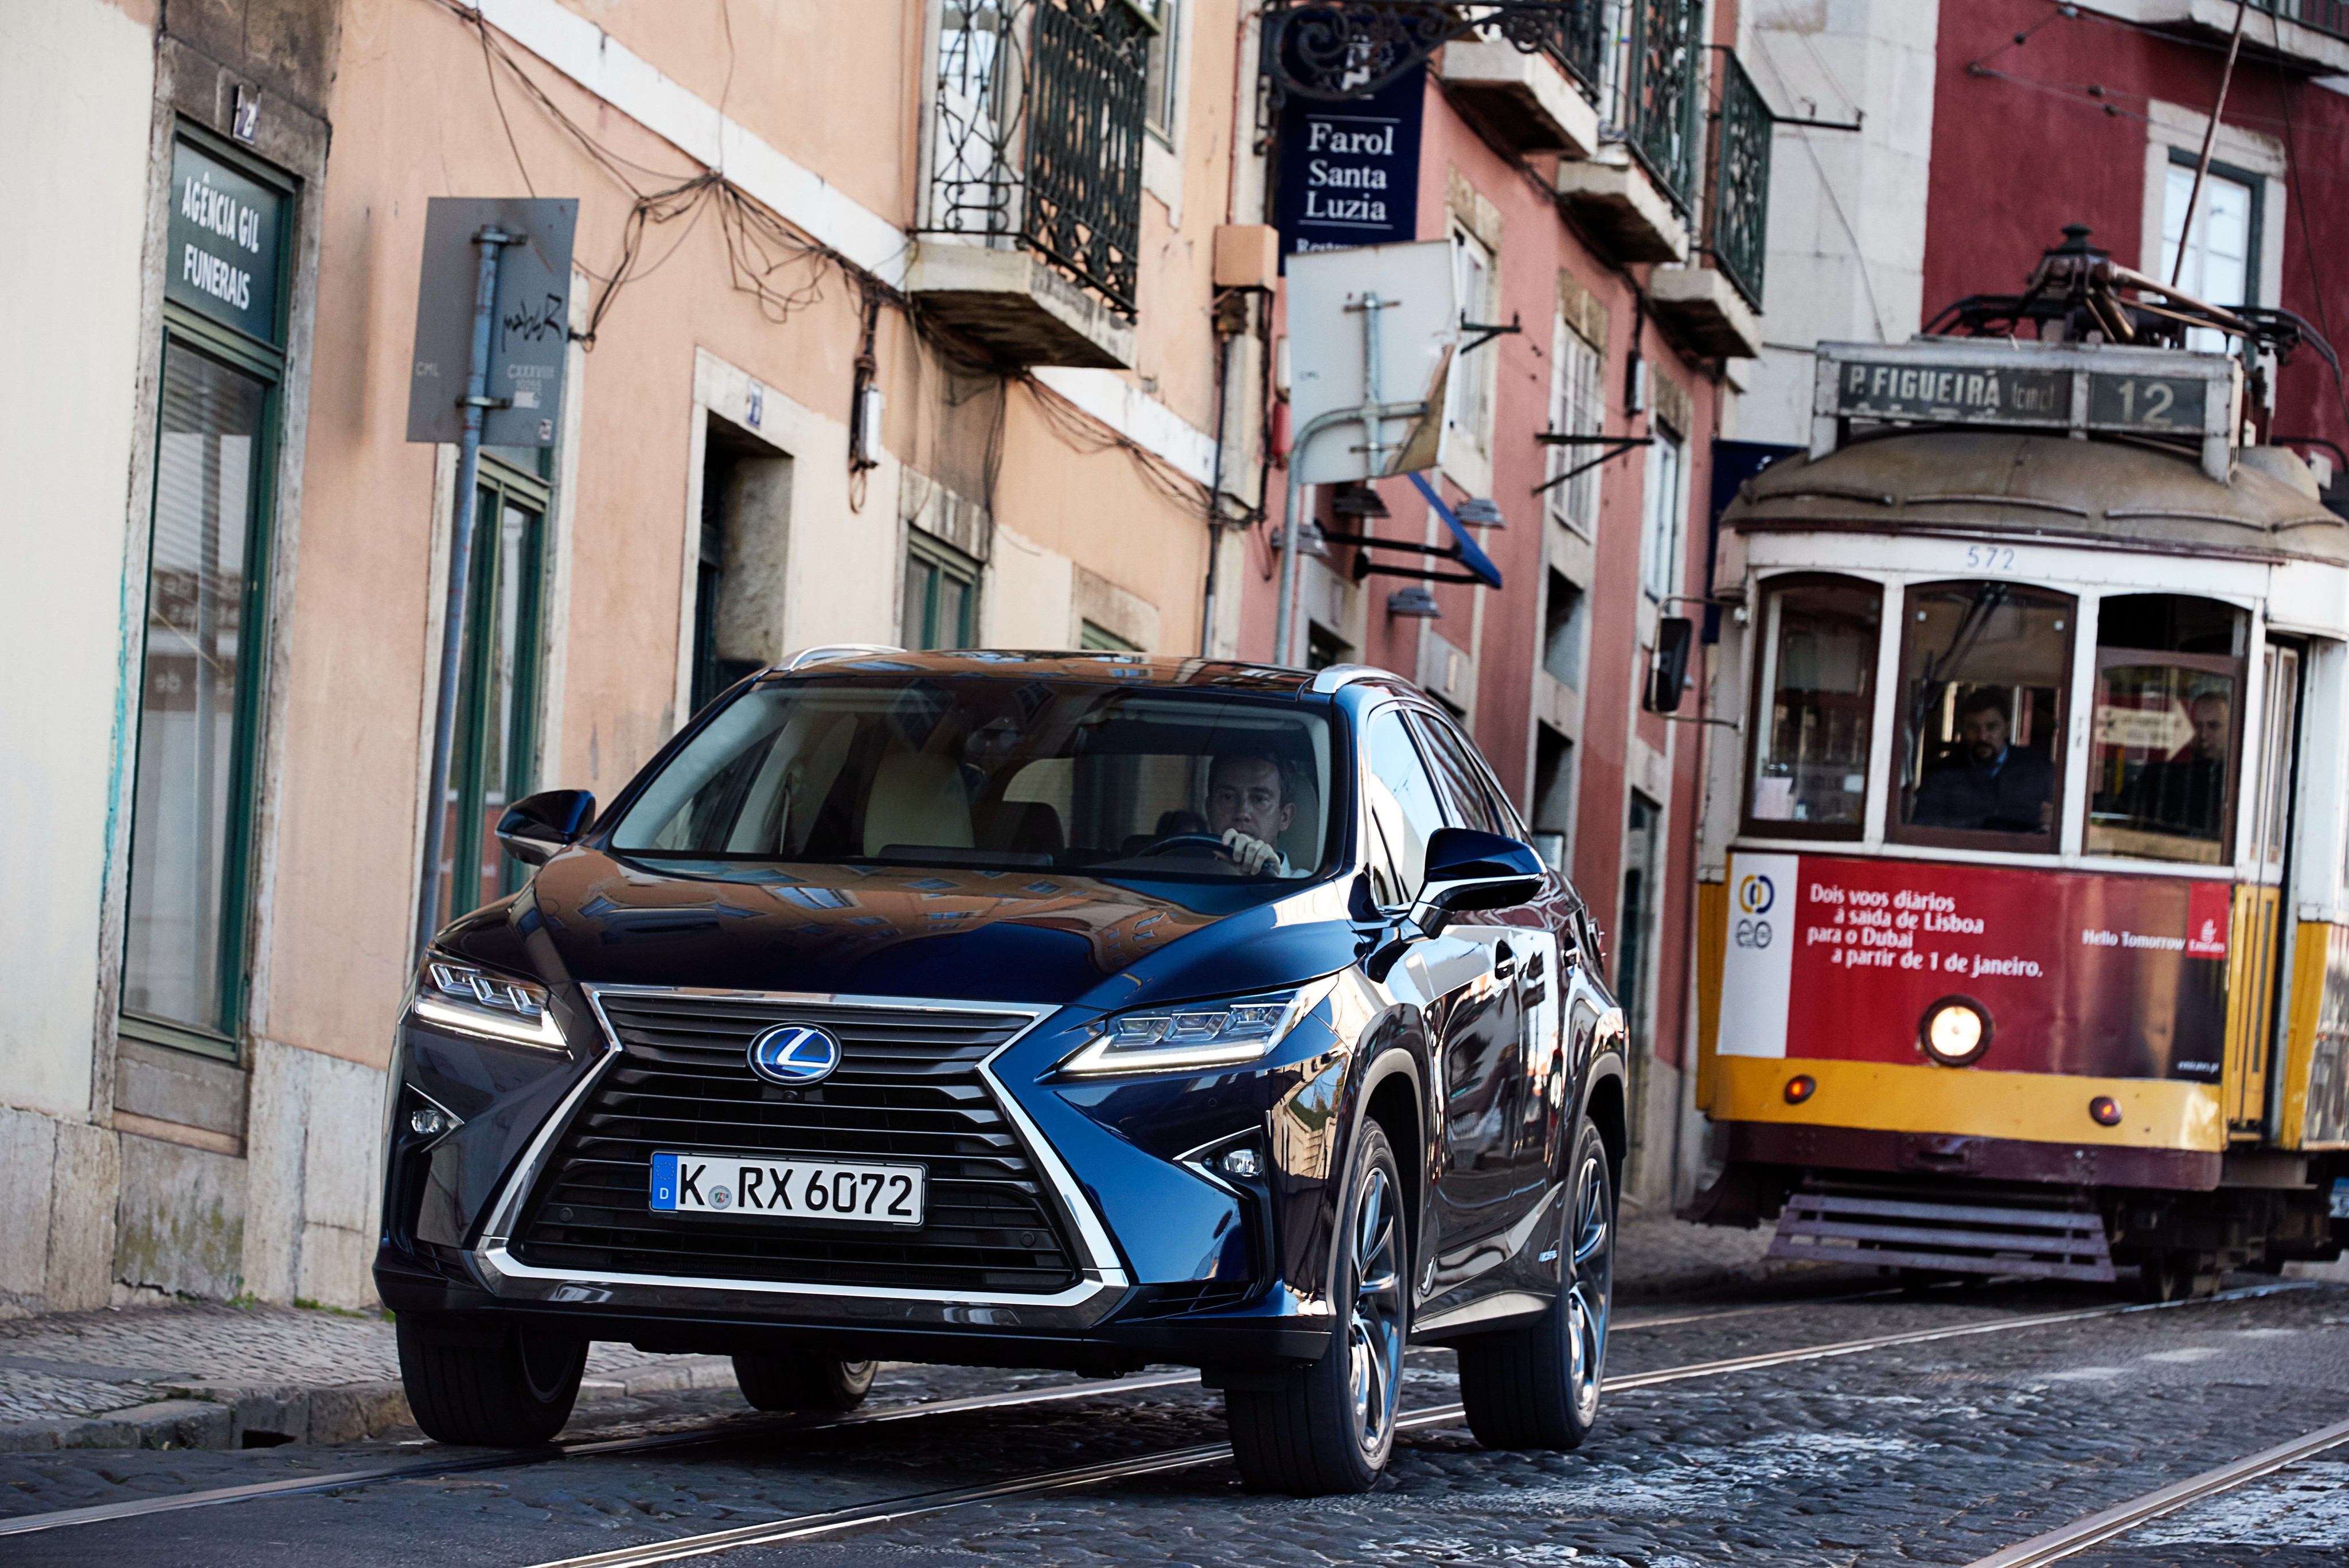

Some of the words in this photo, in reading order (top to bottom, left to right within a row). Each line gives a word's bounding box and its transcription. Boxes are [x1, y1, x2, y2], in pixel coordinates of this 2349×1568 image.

[1307, 122, 1394, 155] Farol
[1308, 158, 1388, 189] Santa
[181, 171, 236, 241] AGÊNCIA
[239, 206, 259, 253] GIL
[1306, 190, 1387, 221] Luzia
[184, 243, 251, 310] FUNERAIS
[2119, 379, 2174, 426] 12
[1967, 545, 2014, 570] 572
[1810, 883, 1845, 904] Dois
[1848, 890, 1889, 907] voos
[1894, 890, 1956, 912] diários
[1848, 908, 1891, 927] saída
[1895, 910, 1919, 930] de
[1923, 911, 1985, 934] Lisboa
[1807, 926, 1842, 946] para
[1844, 929, 1858, 945] o
[1862, 926, 1913, 949] Dubai
[2082, 929, 2119, 946] Hello
[2121, 931, 2186, 951] Tomorrow
[1831, 948, 1843, 964] a
[1845, 948, 1897, 969] partir
[1899, 949, 1923, 970] de
[1930, 951, 1939, 971] 1
[1944, 953, 1968, 973] de
[1969, 954, 2043, 978] janeiro.
[659, 1188, 669, 1200] D
[680, 1164, 707, 1206] K
[738, 1167, 793, 1210] RX
[805, 1170, 912, 1216] 6072
